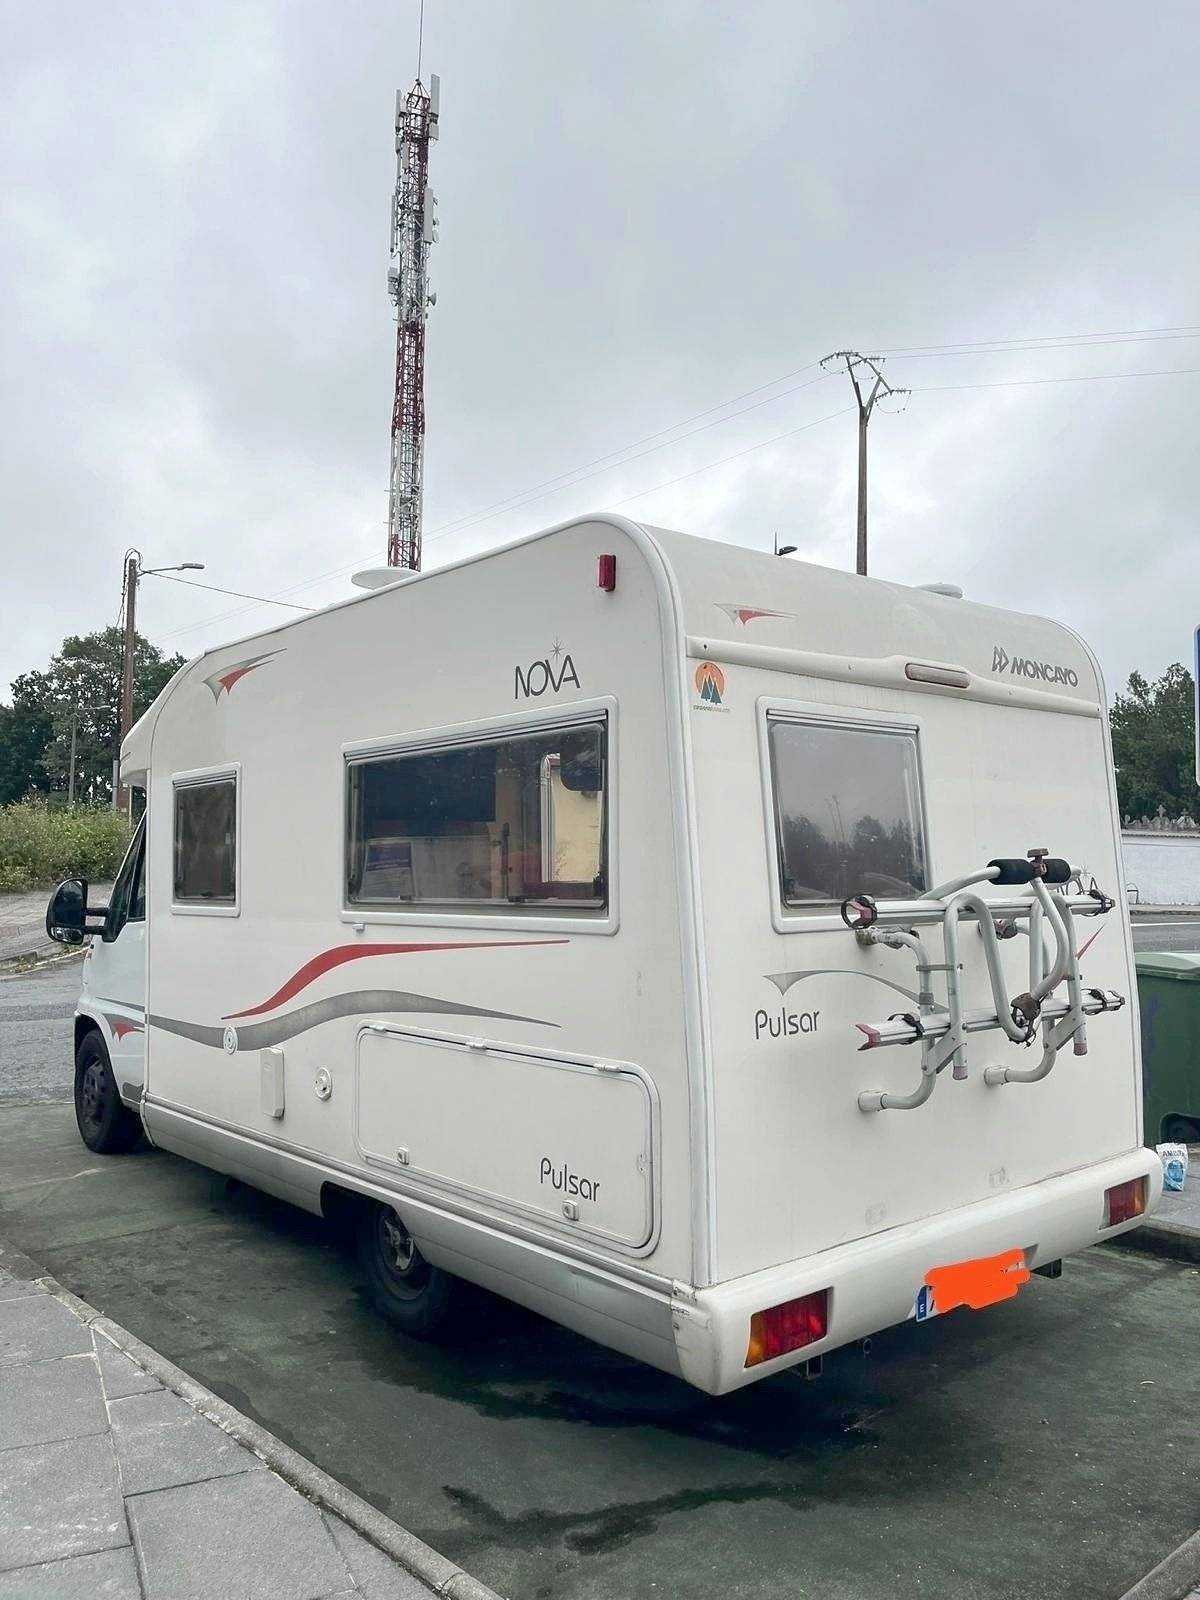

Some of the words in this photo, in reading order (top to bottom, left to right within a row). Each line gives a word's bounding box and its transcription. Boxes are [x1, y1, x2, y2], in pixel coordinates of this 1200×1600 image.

[514, 654, 581, 700] NOVA
[1010, 656, 1079, 688] MONCAYO
[754, 1007, 820, 1040] Pulsar
[540, 1157, 601, 1202] Pulsar
